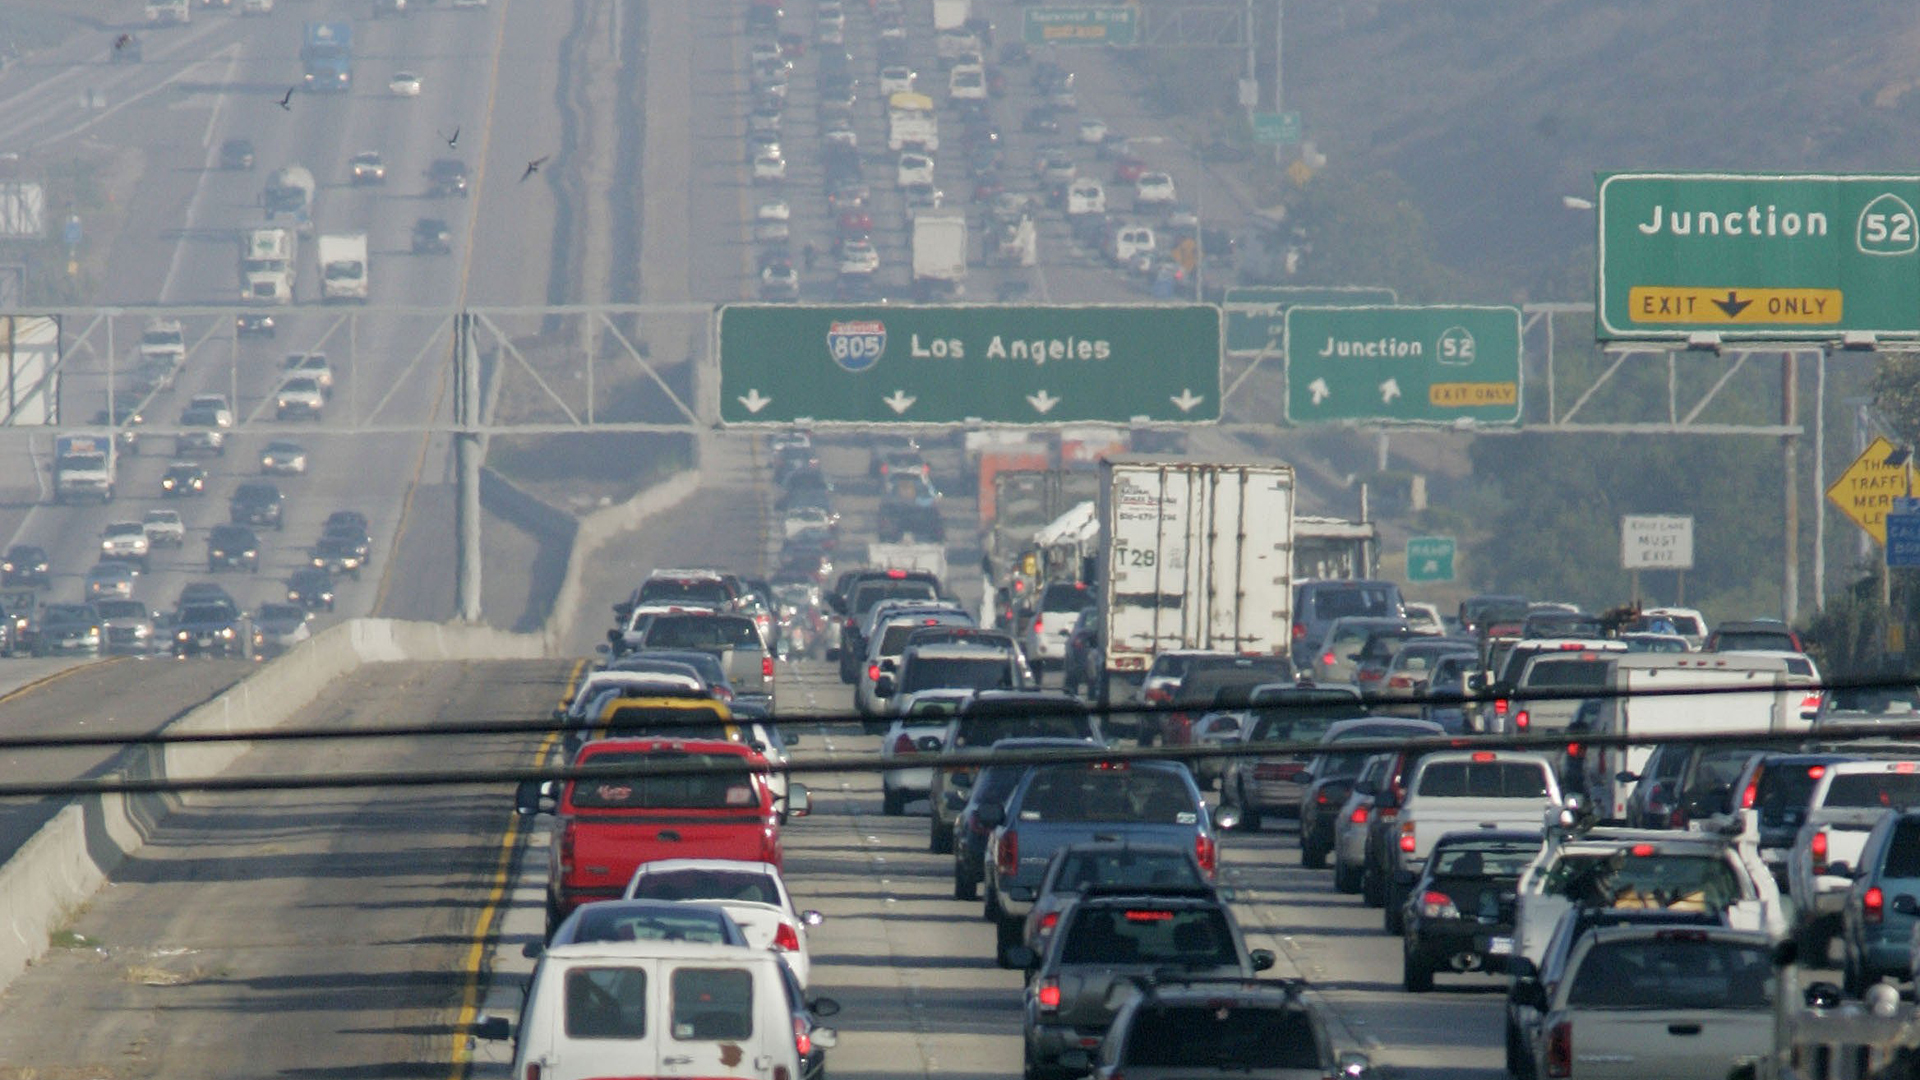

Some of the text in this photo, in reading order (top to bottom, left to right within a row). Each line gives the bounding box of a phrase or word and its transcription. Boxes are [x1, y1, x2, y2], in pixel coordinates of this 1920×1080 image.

[1639, 204, 1912, 242] Junction 52
[1643, 295, 1827, 315] EXIT ONLY
[835, 335, 880, 359] 805
[910, 333, 1112, 365] Los Angeles
[1319, 337, 1474, 357] Junction 52
[1434, 387, 1511, 399] EXIT ONLY
[1851, 475, 1905, 490] TRAFFI
[1638, 535, 1677, 547] MUST
